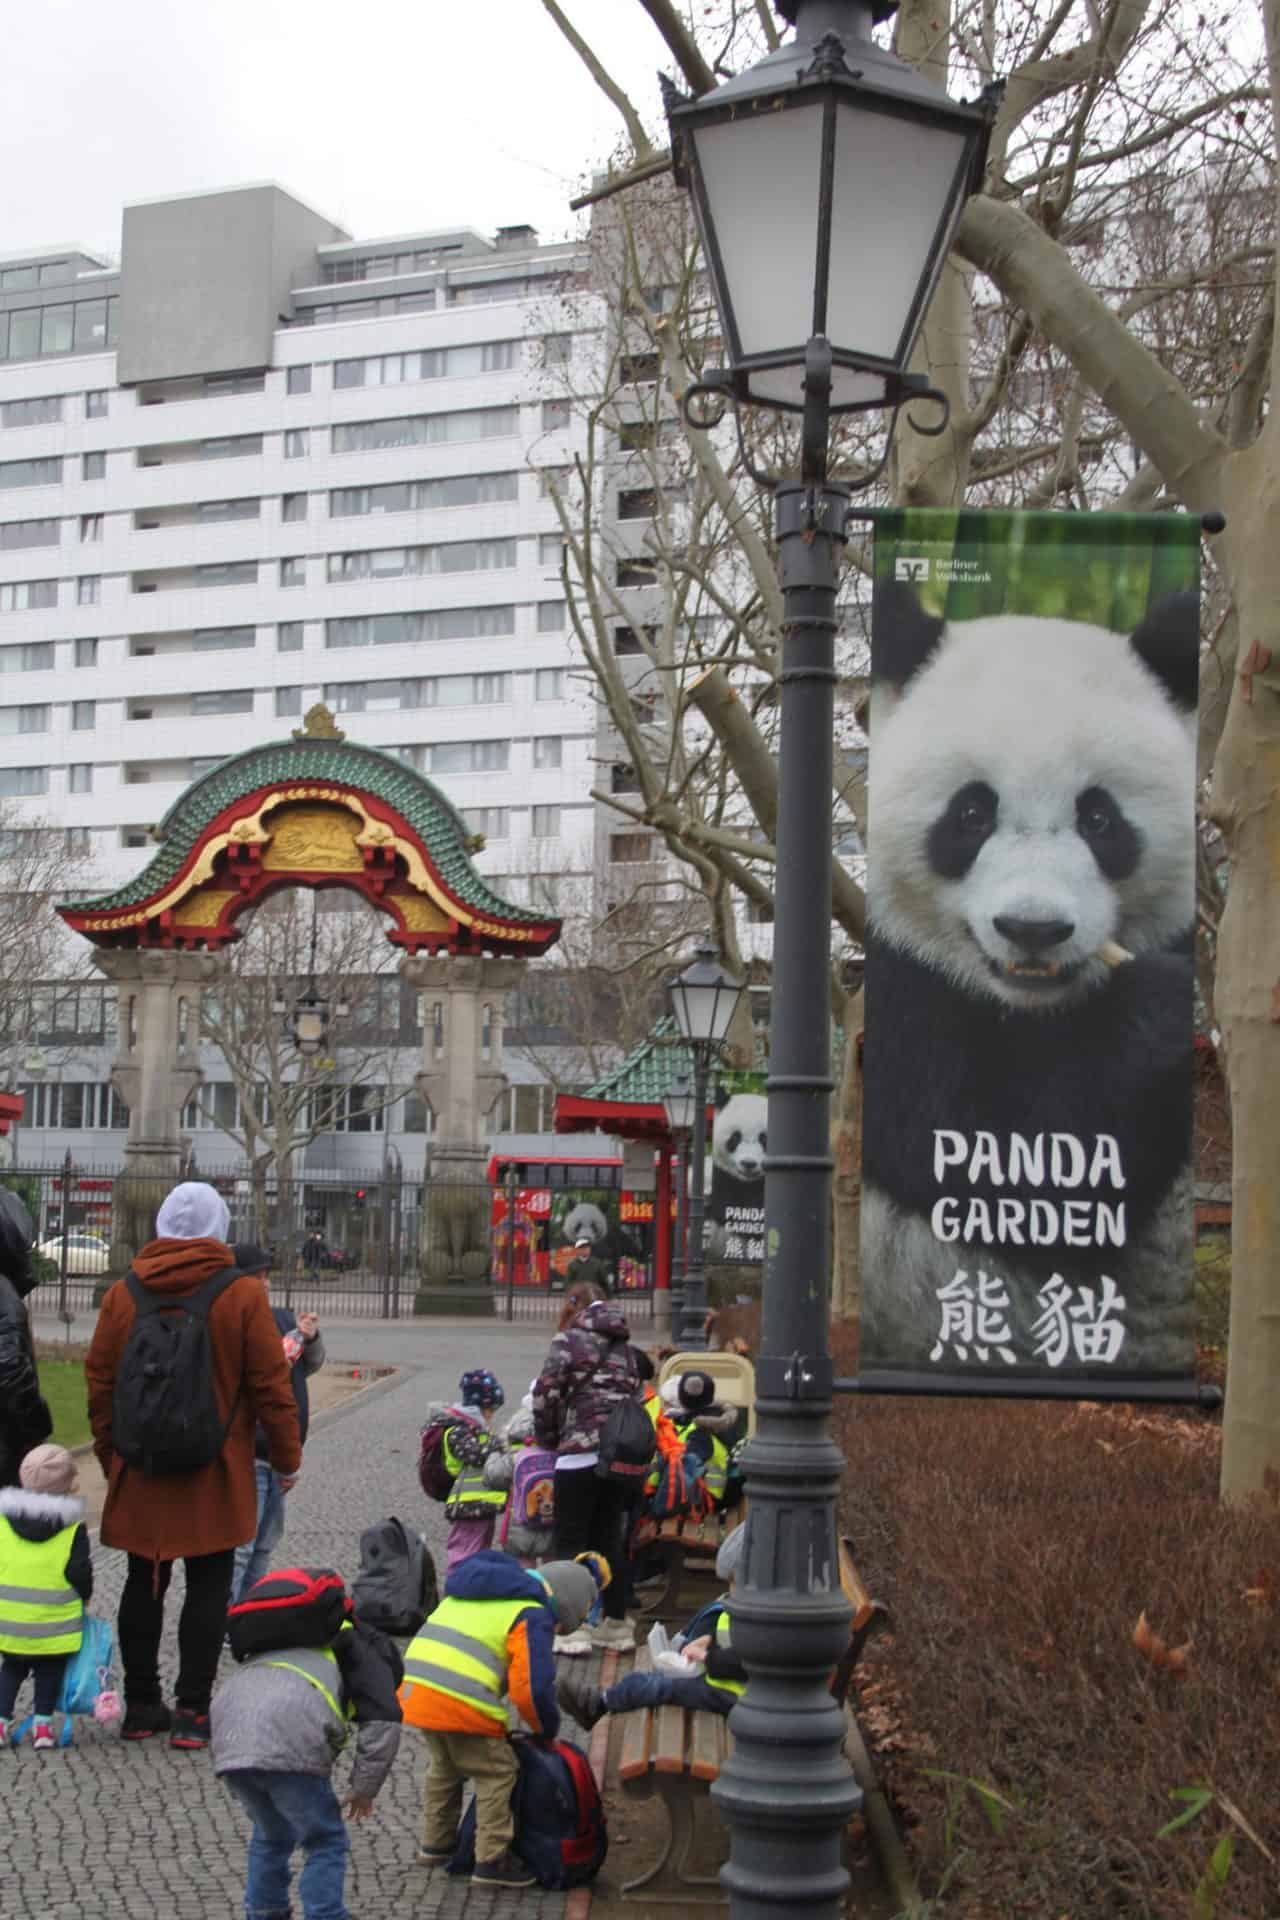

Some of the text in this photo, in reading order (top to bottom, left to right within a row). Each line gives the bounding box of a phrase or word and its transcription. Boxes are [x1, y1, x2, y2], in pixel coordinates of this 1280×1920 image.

[932, 1129, 1127, 1189] PANDA
[931, 1196, 1127, 1248] GARDEN
[930, 1269, 1127, 1367] 熊貓
